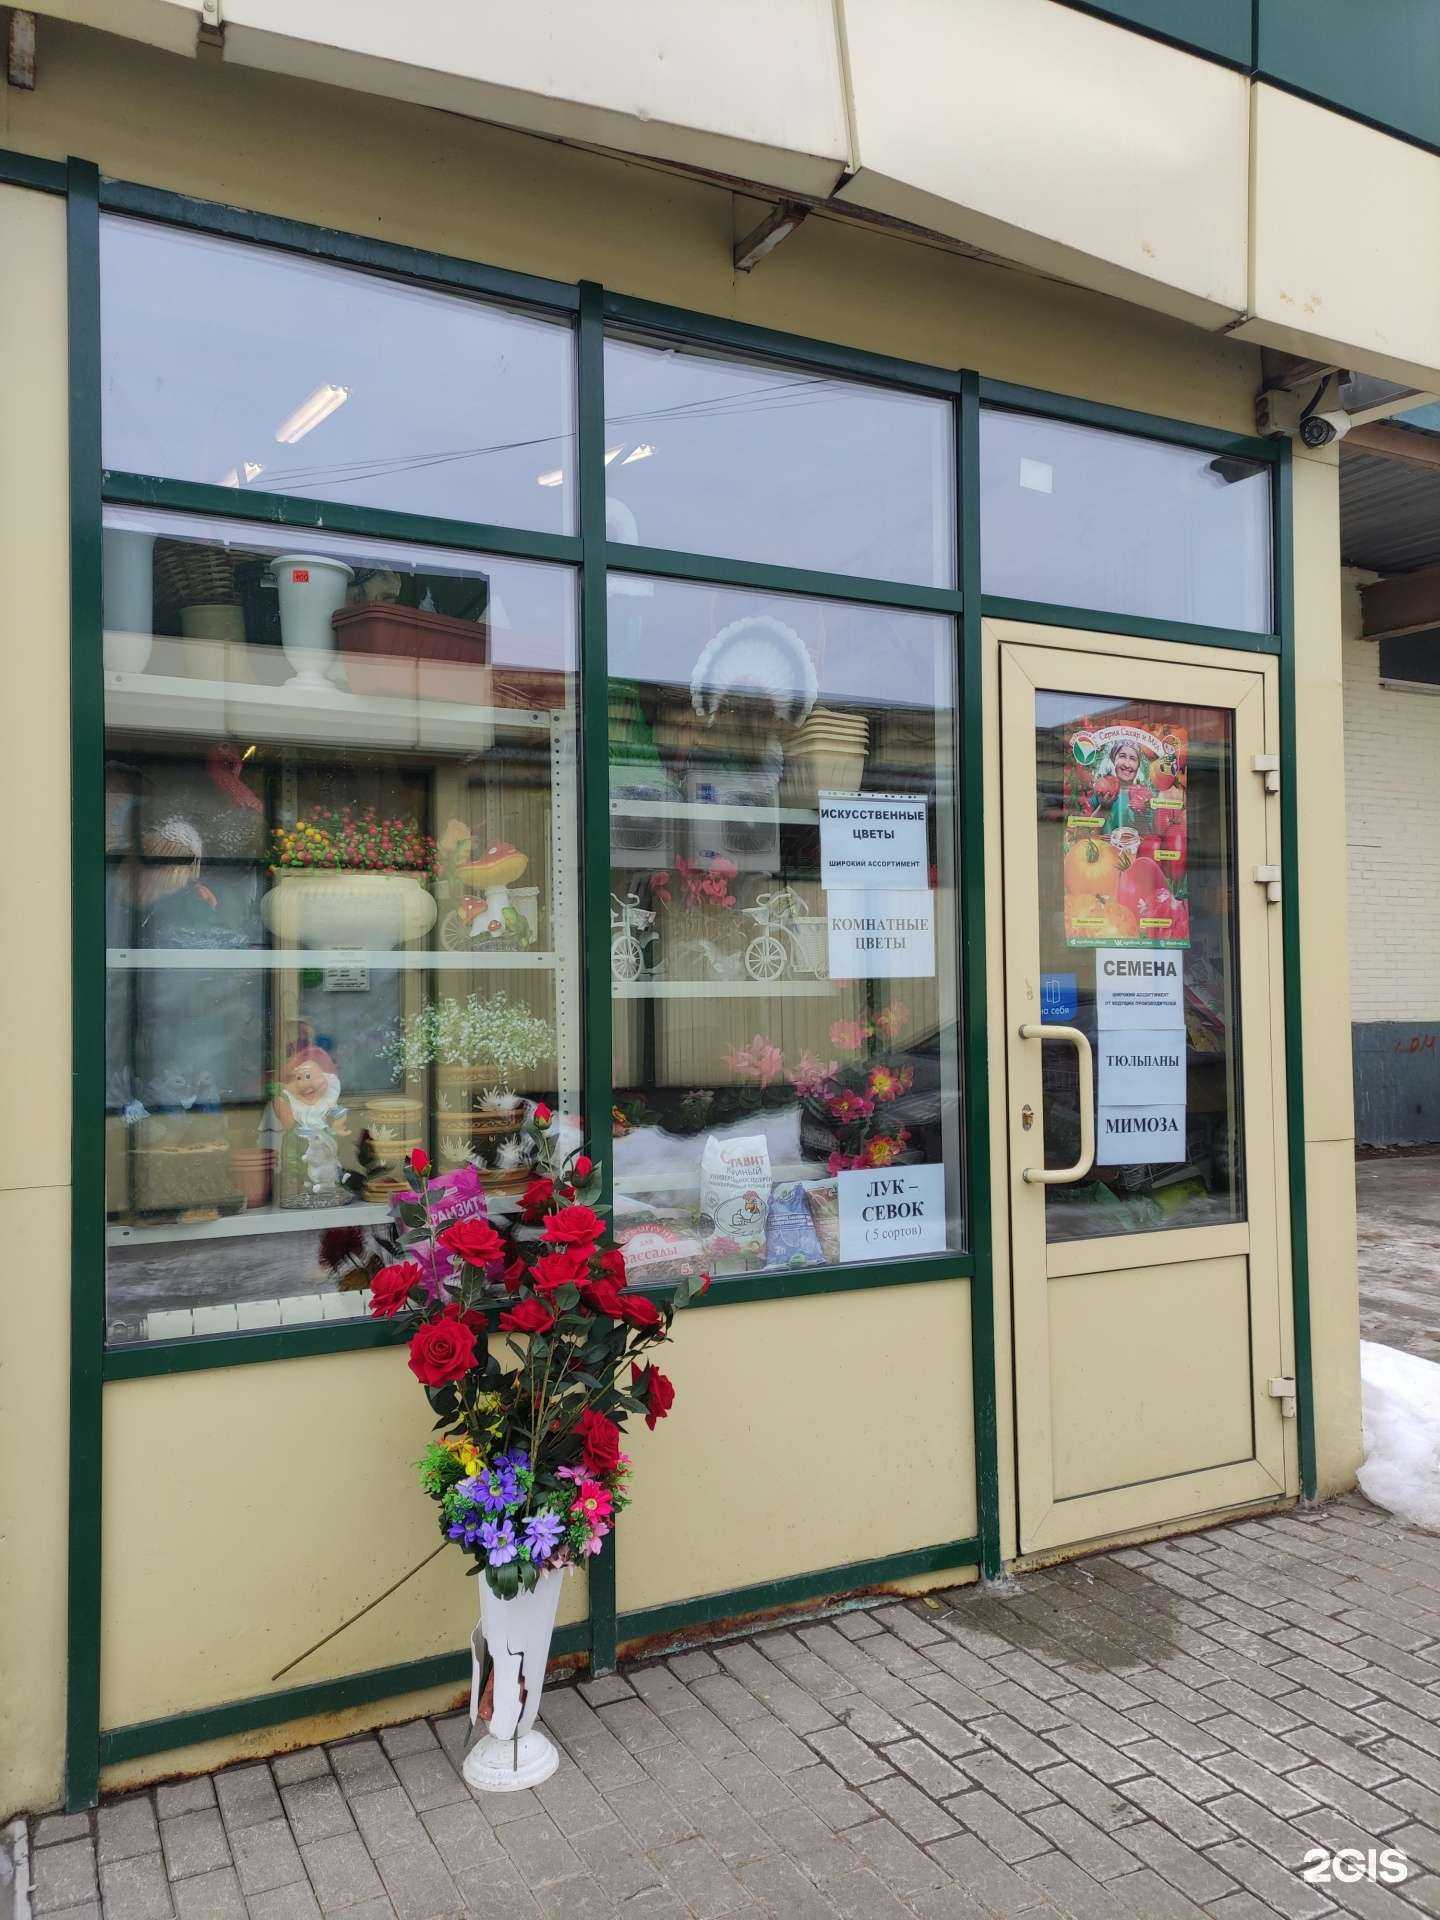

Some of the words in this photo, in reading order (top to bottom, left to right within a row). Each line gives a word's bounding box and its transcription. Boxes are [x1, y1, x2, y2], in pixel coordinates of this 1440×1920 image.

[821, 809, 925, 821] ИСКУССТВЕННЫЕ
[853, 829, 895, 840] ЦВЕТЫ
[868, 860, 921, 868] АССОРТИМЕНТ
[832, 918, 929, 931] КОМНАТНЫЕ
[855, 937, 908, 950] ЦВЕТЫ
[1103, 960, 1177, 977] СЕМЕНА
[1051, 1005, 1070, 1015] себя
[1106, 1055, 1179, 1067] ТЮЛЬПАНЫ
[1106, 1117, 1178, 1134] МИМОЗА
[866, 1179, 905, 1198] ЛУК
[431, 1196, 479, 1227] РАМЗИТ
[862, 1202, 924, 1222] СЕВОК
